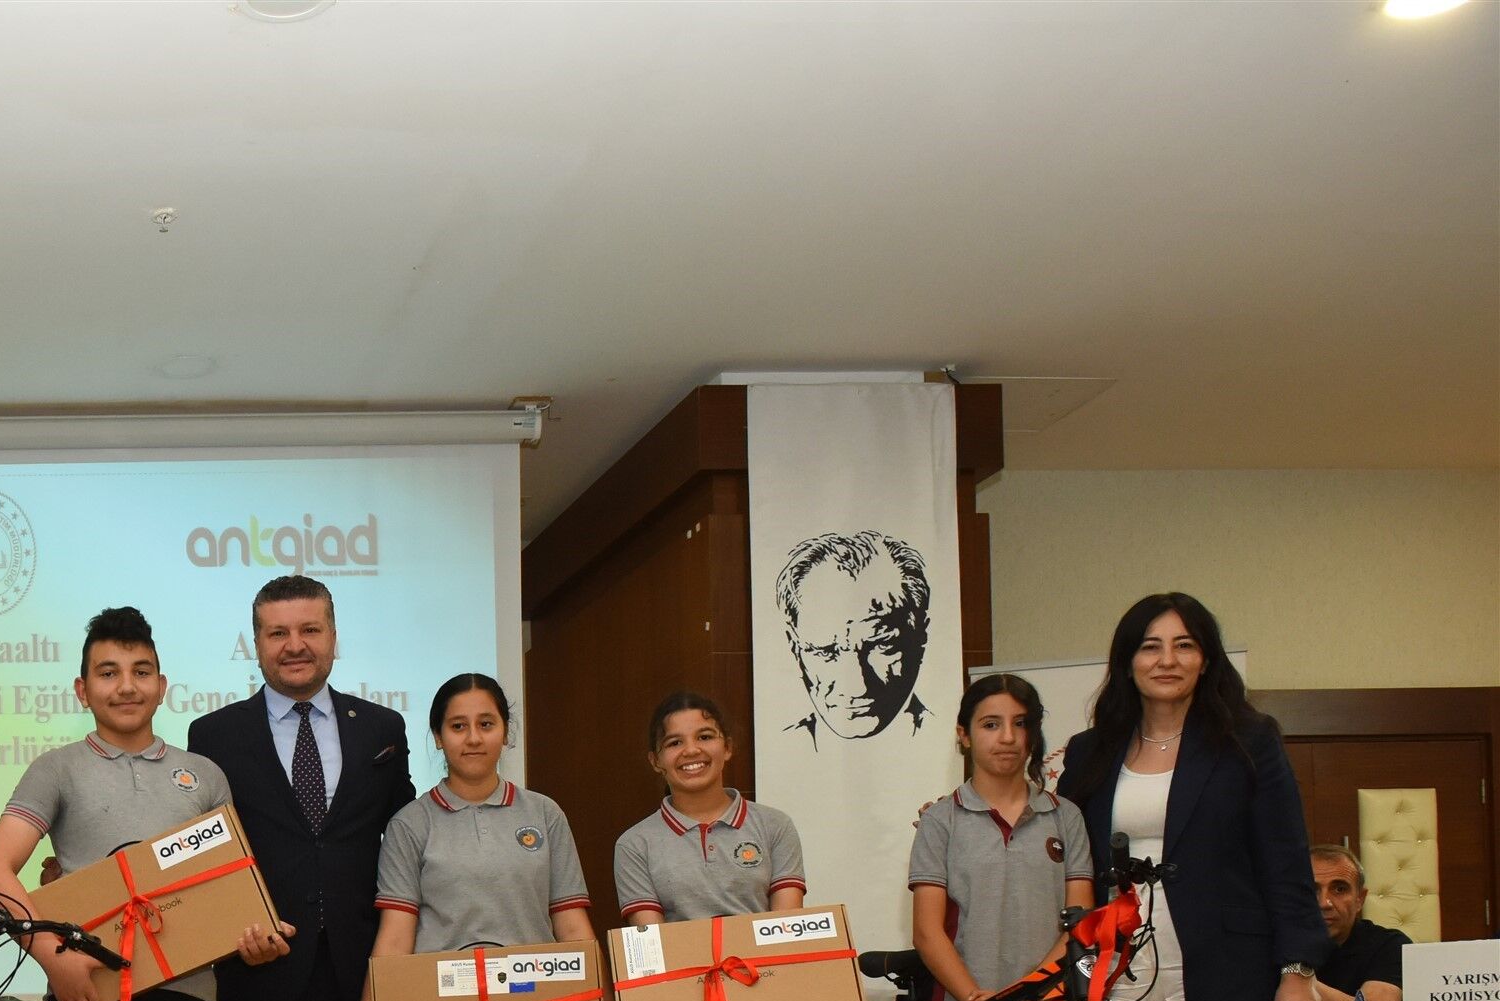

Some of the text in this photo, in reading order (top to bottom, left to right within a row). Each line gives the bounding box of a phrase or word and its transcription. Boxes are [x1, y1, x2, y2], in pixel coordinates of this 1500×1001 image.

[186, 513, 378, 576] antgiad
[12, 685, 93, 723] Eğiti
[160, 820, 224, 858] antgiad
[114, 914, 139, 932] ASS
[759, 917, 831, 937] antgiad
[512, 957, 581, 977] antgiad
[1442, 973, 1500, 985] YARIŞM
